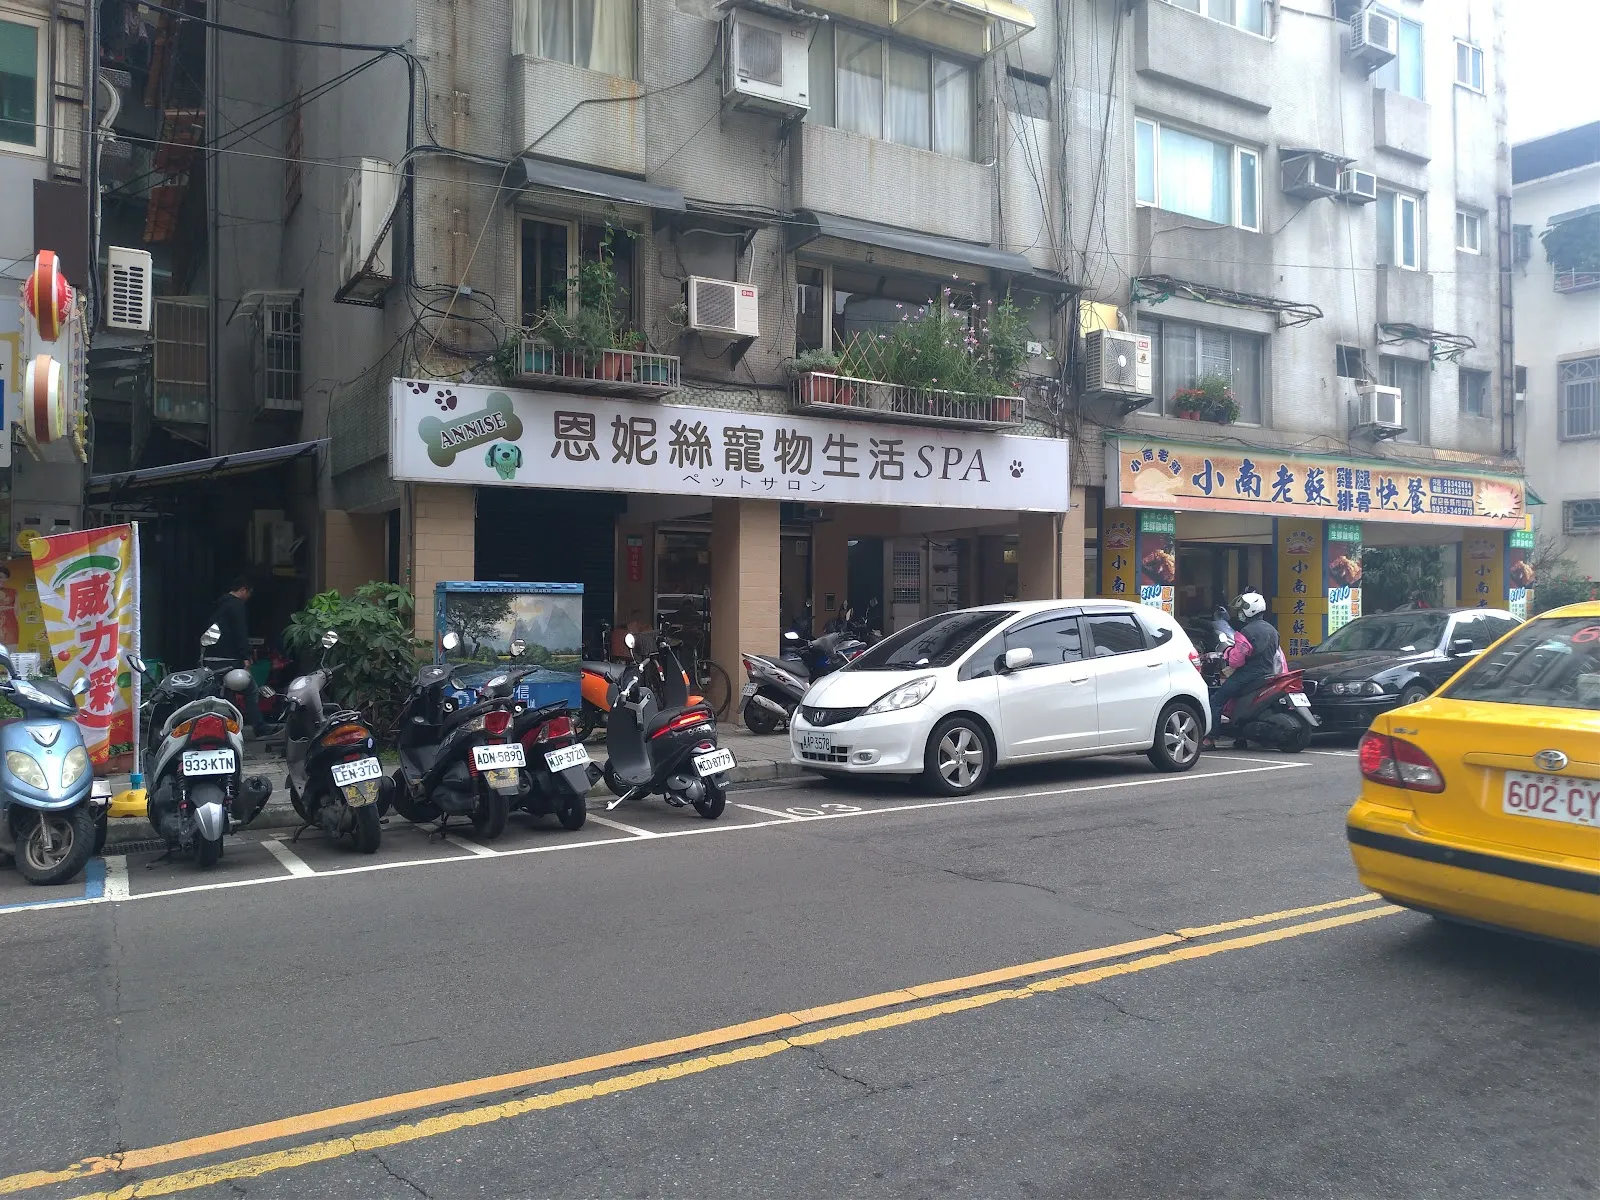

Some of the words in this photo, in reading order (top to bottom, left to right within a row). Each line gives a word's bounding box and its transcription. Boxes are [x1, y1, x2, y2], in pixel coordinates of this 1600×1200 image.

[440, 412, 506, 449] ANNISE
[551, 410, 905, 481] 恩妮絲寵物生活
[914, 445, 991, 483] SPA
[682, 473, 826, 493] ペットサロン
[1375, 476, 1427, 514] 快餐
[68, 572, 120, 713] 威力彩
[185, 757, 234, 772] 933-KTN
[477, 750, 523, 765] ADN-5890
[547, 748, 586, 768] MJP-3720
[697, 753, 731, 773] MCD-8779
[334, 764, 380, 783] LEN-370
[1507, 780, 1600, 819] 602-CY
